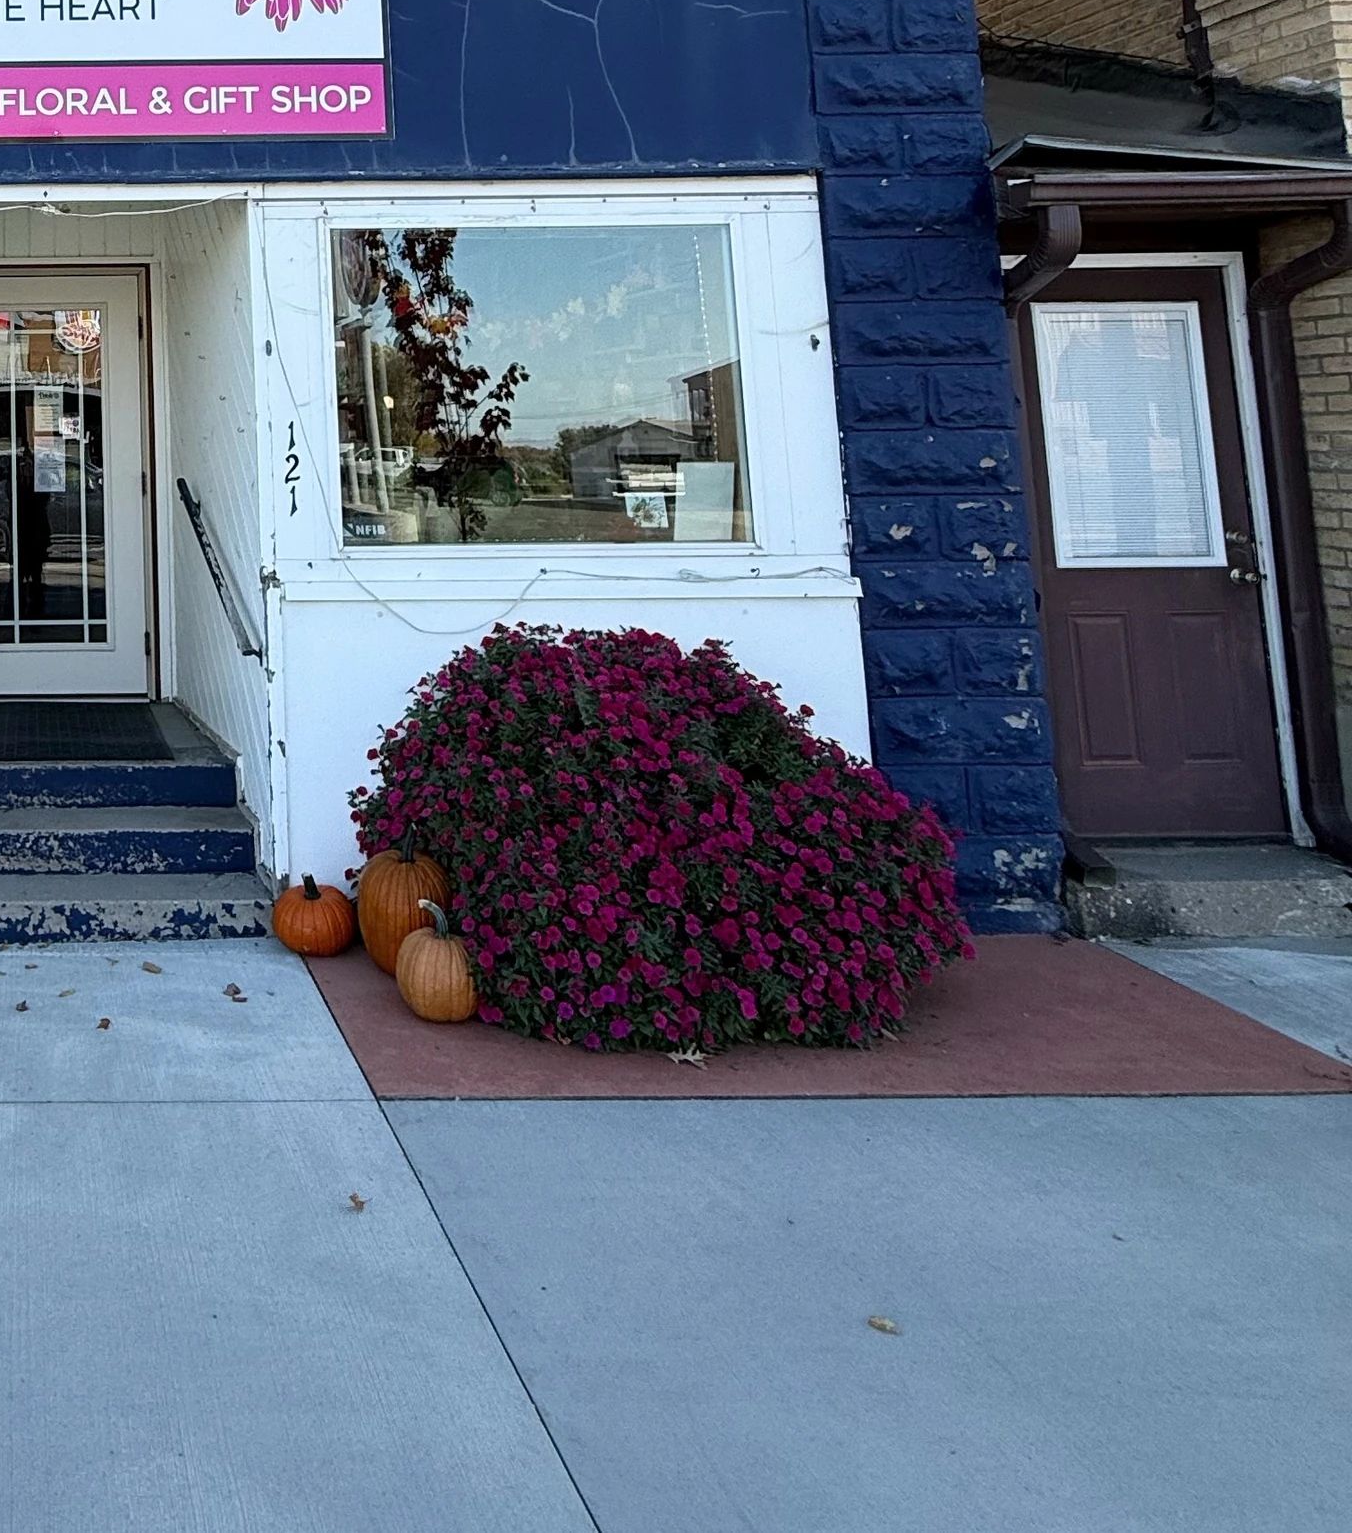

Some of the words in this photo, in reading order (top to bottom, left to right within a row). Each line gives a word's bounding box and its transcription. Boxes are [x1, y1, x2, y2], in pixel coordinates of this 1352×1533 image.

[148, 85, 173, 115] &
[183, 85, 258, 115] GIFT
[270, 84, 373, 114] SHOP
[284, 420, 301, 517] 121
